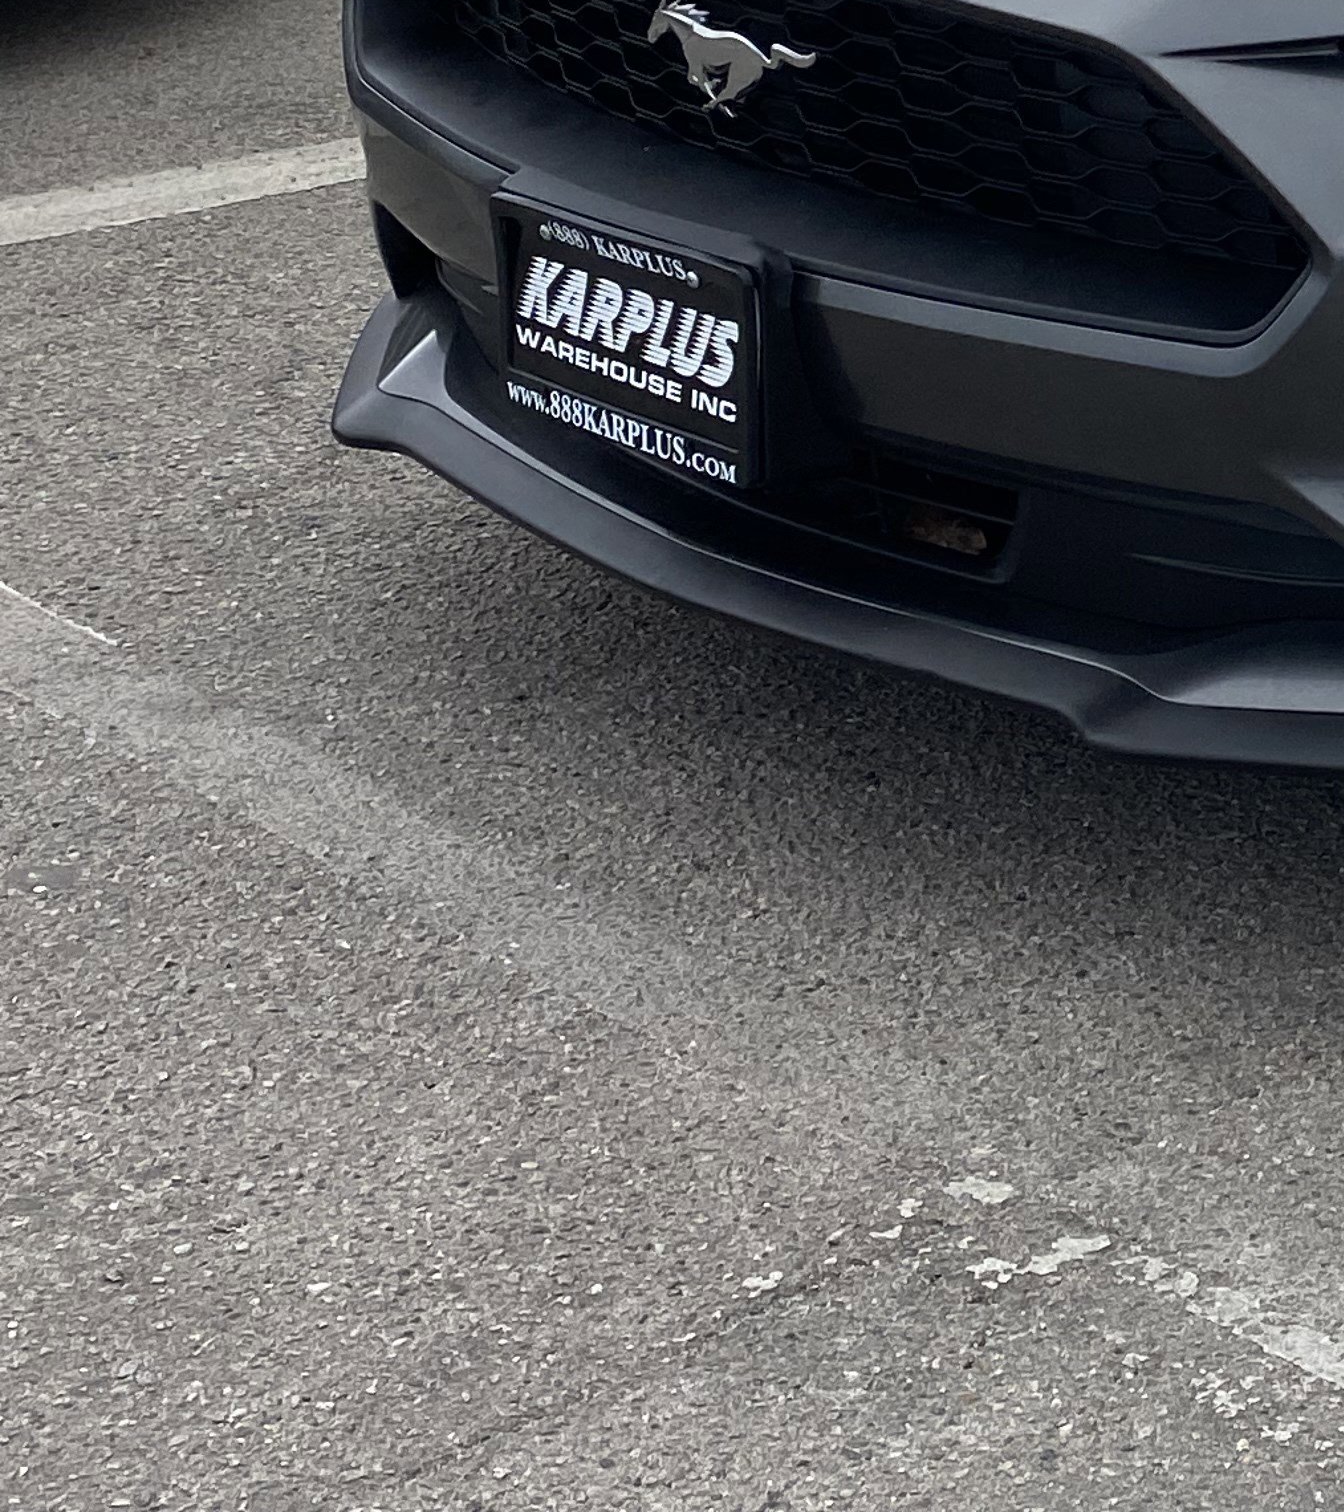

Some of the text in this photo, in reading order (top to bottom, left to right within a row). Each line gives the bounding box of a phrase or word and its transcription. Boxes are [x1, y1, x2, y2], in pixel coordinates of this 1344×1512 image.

[547, 220, 687, 281] (888) KARPLUS
[516, 255, 739, 388] KARPLUS
[515, 324, 738, 423] WAREHOUSE INC
